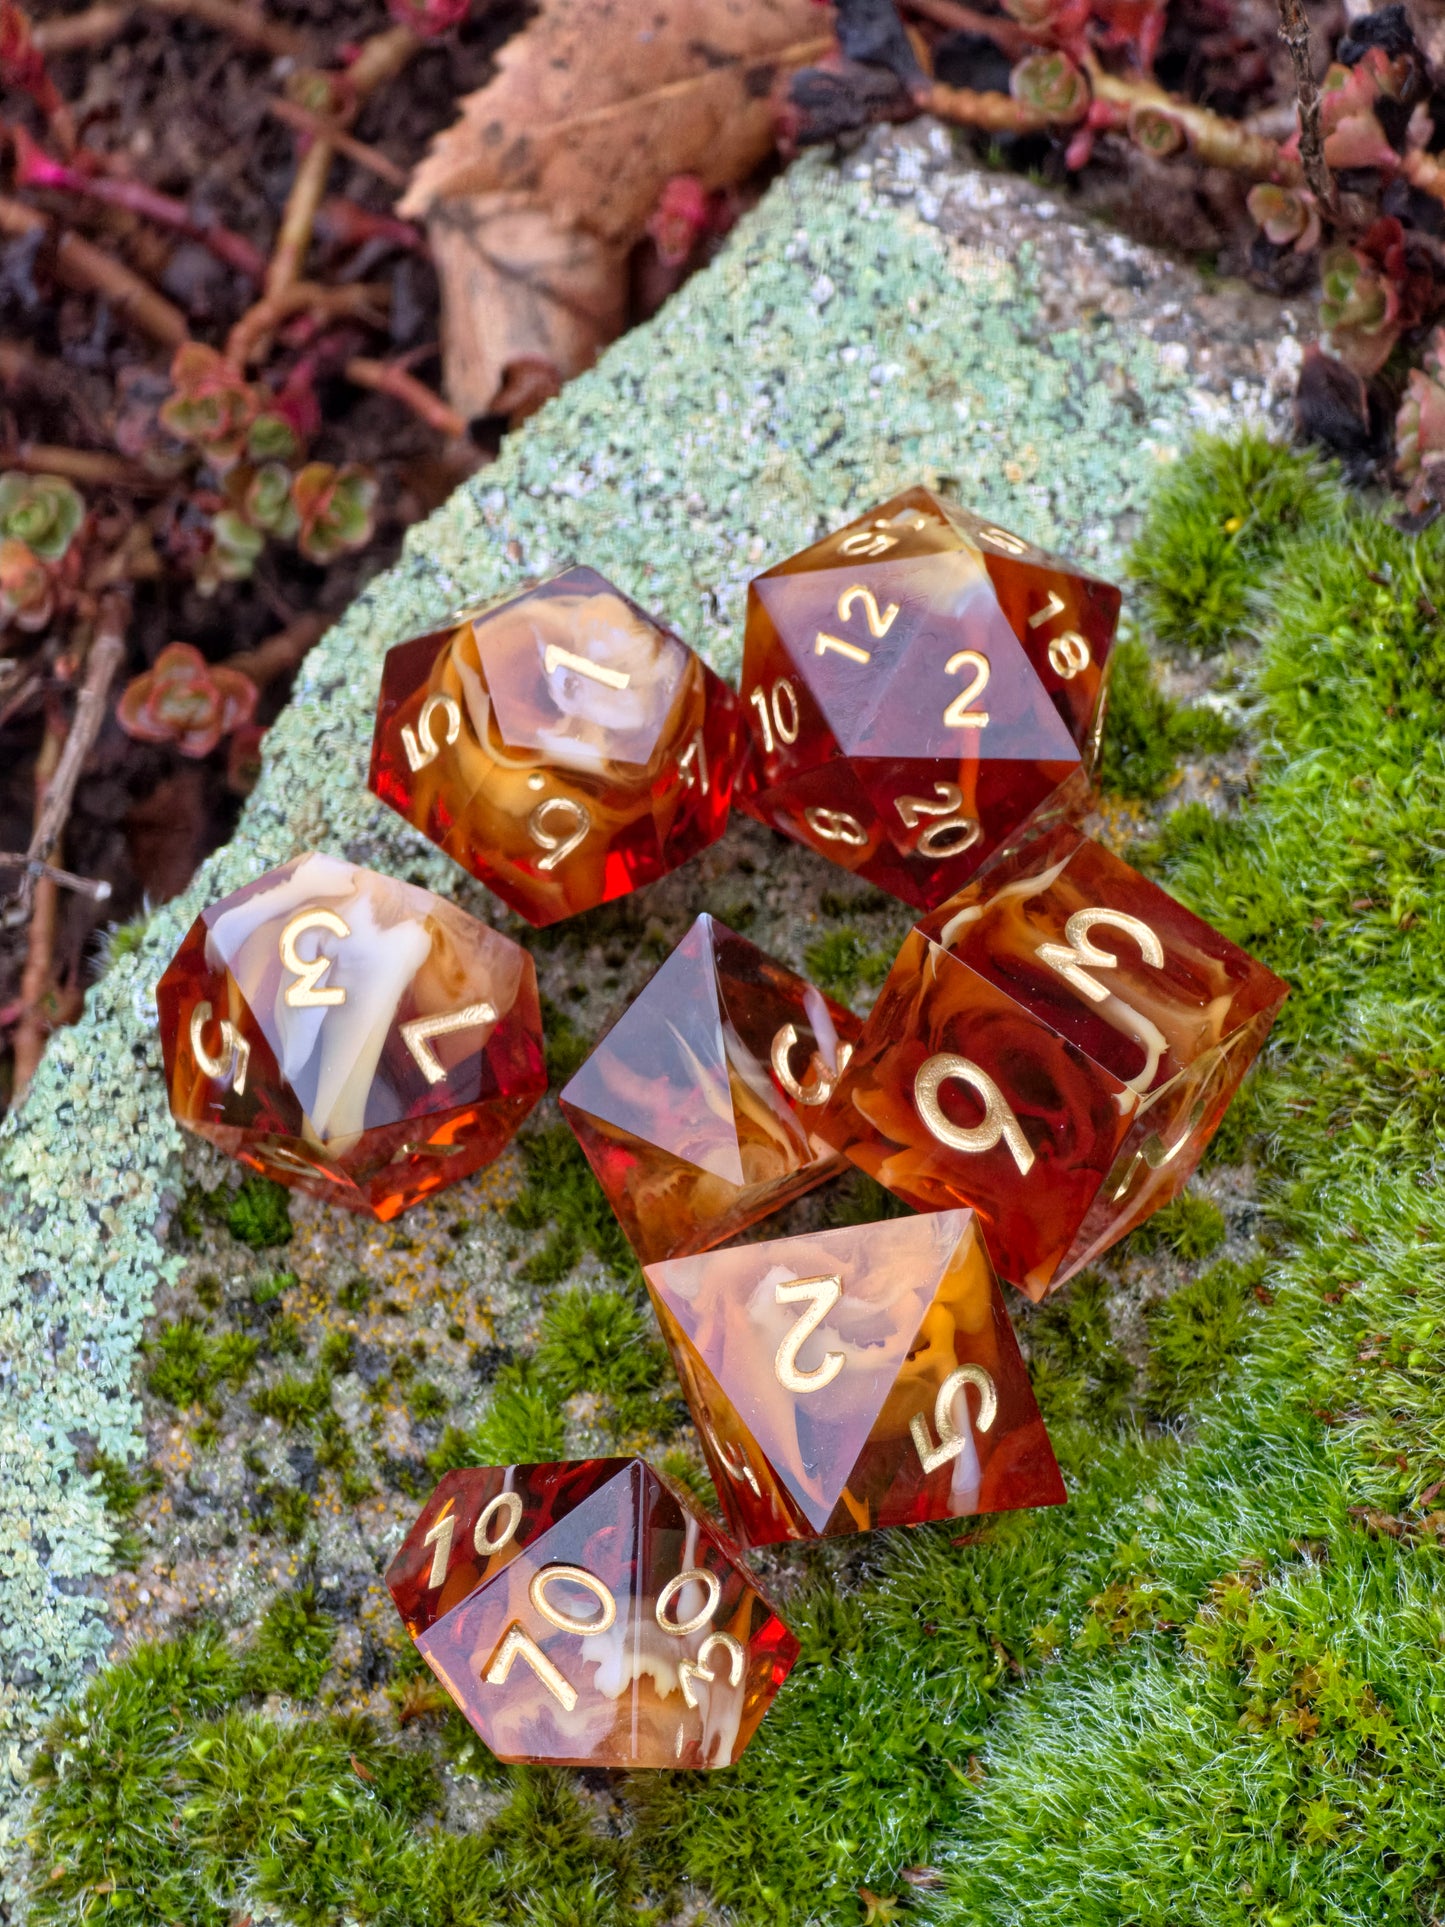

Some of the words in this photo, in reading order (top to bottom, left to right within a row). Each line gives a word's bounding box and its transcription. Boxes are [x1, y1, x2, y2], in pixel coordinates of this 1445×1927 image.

[544, 644, 630, 689] 1
[815, 584, 899, 664] 12
[1028, 590, 1091, 680] 18
[401, 694, 461, 773] 5
[750, 676, 799, 753] 10
[943, 650, 990, 728] 2
[804, 806, 868, 846] 8
[893, 780, 980, 858] 20
[279, 907, 351, 1008] 3
[1035, 907, 1164, 1002] 3
[190, 1001, 250, 1097] 5
[401, 1001, 498, 1085] 7
[775, 1274, 846, 1393] 2
[909, 1363, 997, 1475] 5
[423, 1491, 523, 1590] 10
[481, 1565, 616, 1711] 70
[656, 1567, 745, 1709] 30
